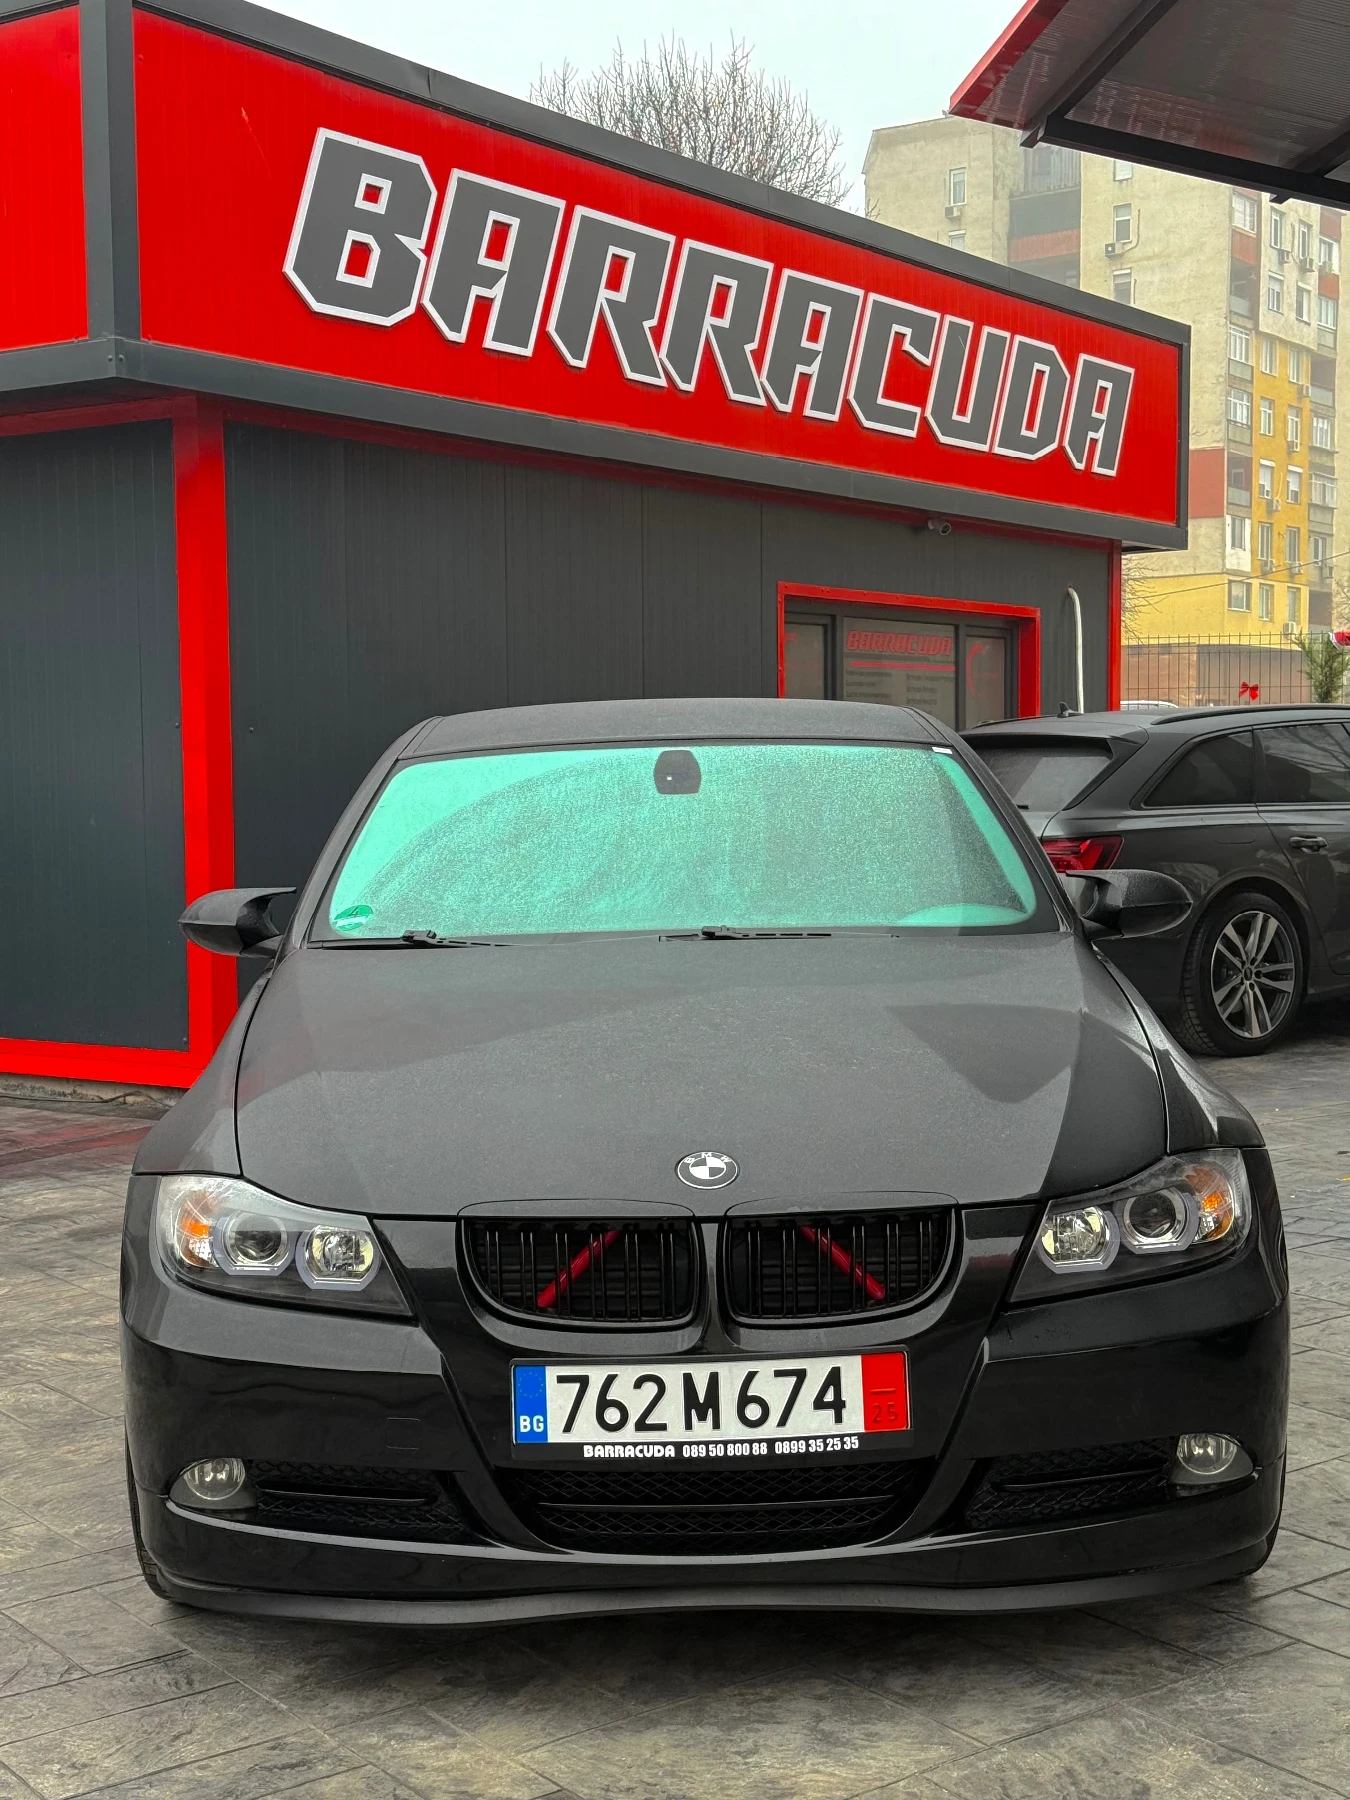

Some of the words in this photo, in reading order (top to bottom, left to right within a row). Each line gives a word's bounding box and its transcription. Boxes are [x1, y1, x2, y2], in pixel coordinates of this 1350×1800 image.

[282, 127, 1135, 477] BARRACUDA
[847, 630, 952, 656] BARRACUDA
[556, 1373, 668, 1433] 762
[682, 1371, 721, 1431] M
[736, 1366, 847, 1429] 674
[519, 1415, 545, 1433] BG
[872, 1402, 899, 1423] 25
[583, 1444, 676, 1458] BARRACUDA
[682, 1444, 706, 1458] 089
[708, 1443, 725, 1457] 50
[726, 1443, 750, 1456] 800
[752, 1442, 768, 1455] 88
[774, 1440, 807, 1454] 0899
[808, 1438, 825, 1452] 35
[826, 1437, 842, 1451] 25
[843, 1436, 860, 1449] 35
